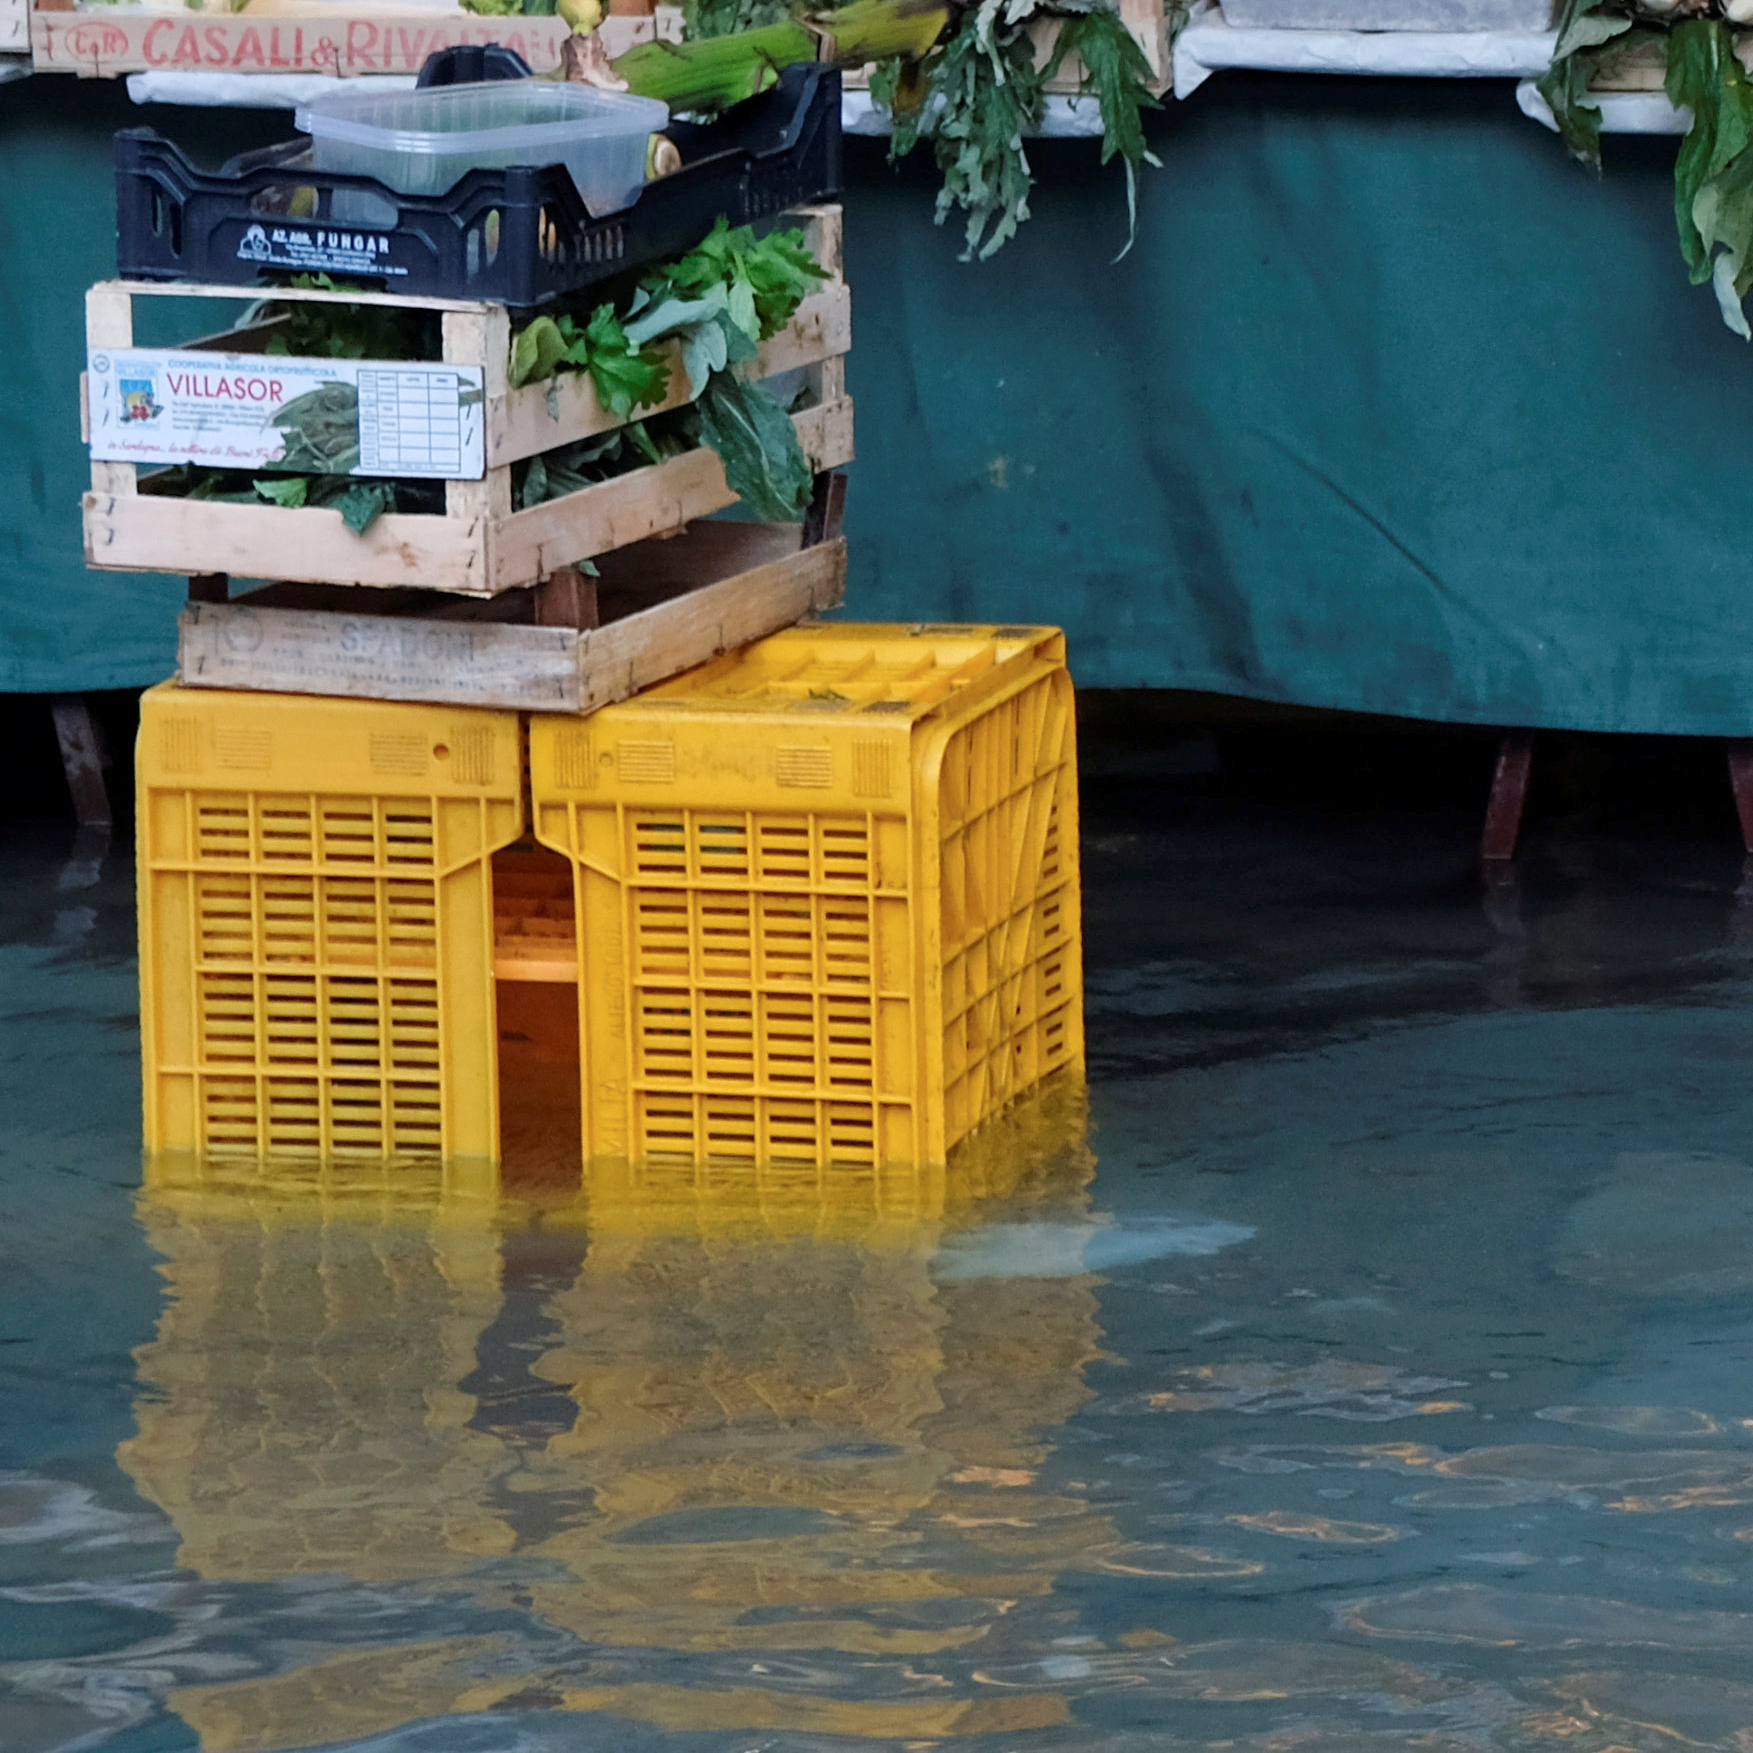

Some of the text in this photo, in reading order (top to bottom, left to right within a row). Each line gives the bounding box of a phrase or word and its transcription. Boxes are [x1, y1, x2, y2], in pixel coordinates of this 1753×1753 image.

[142, 18, 303, 69] CASALI
[310, 34, 338, 69] &
[271, 228, 288, 244] AZ.
[168, 358, 222, 371] COOPERATIVA
[223, 361, 265, 375] AGRICOLA
[166, 372, 284, 403] VILLASOR
